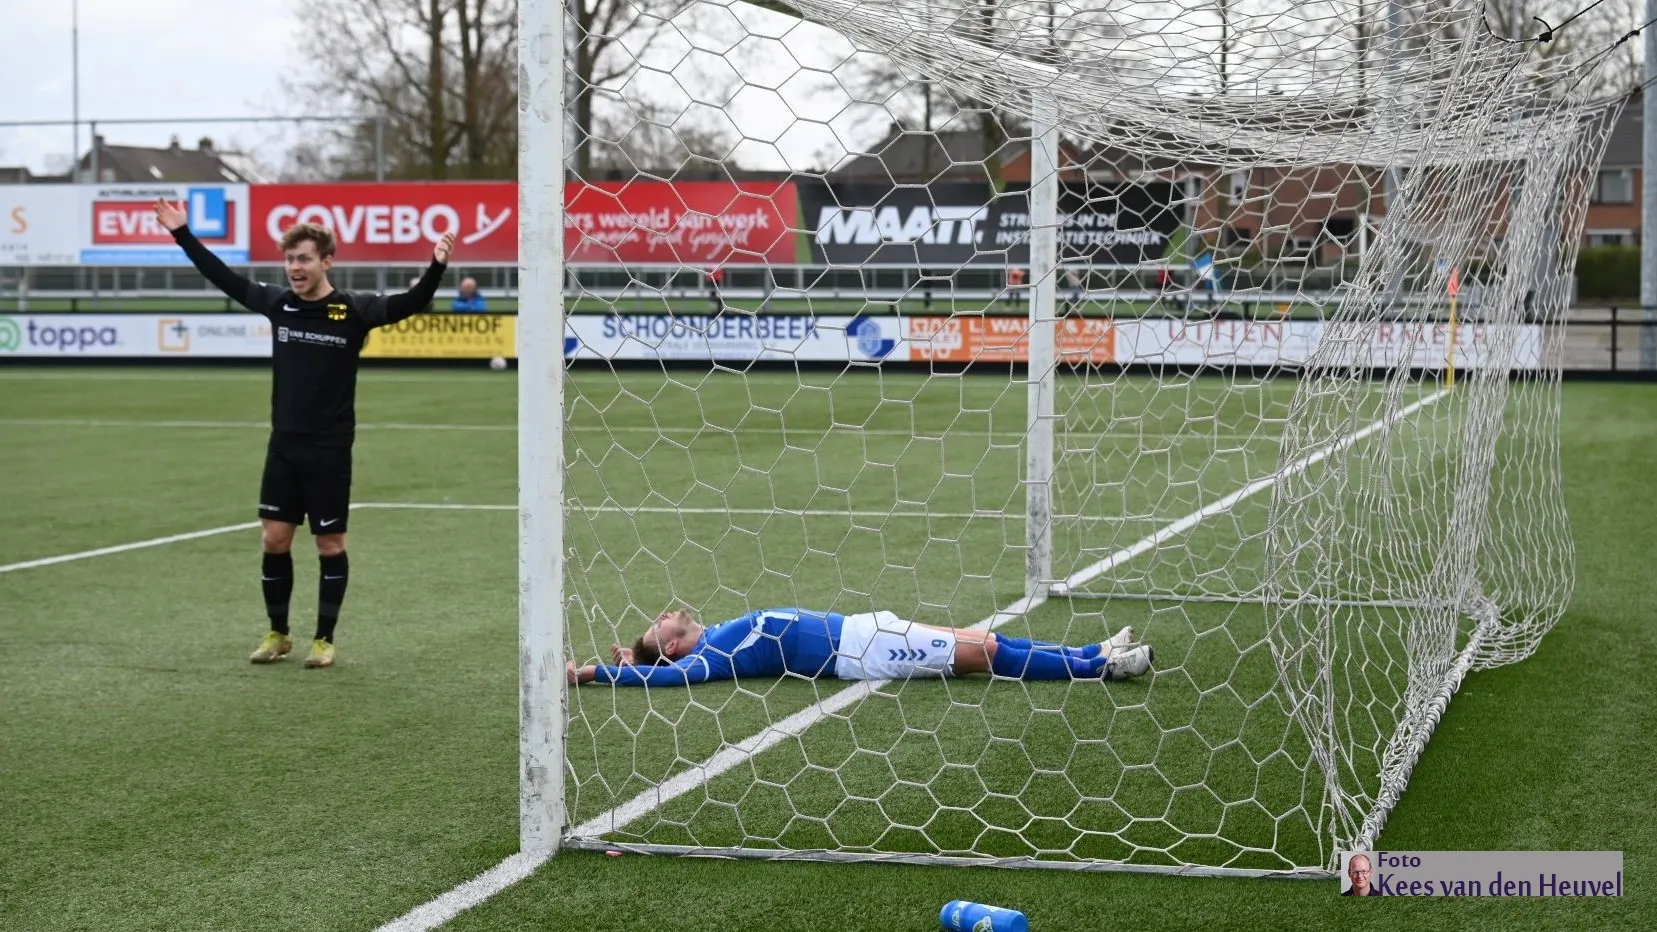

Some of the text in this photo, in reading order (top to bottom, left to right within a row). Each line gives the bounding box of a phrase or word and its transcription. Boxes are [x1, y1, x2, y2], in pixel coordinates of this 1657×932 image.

[598, 208, 670, 228] wereld
[719, 208, 769, 229] werk
[602, 316, 820, 340] SCHOONDERBEEK
